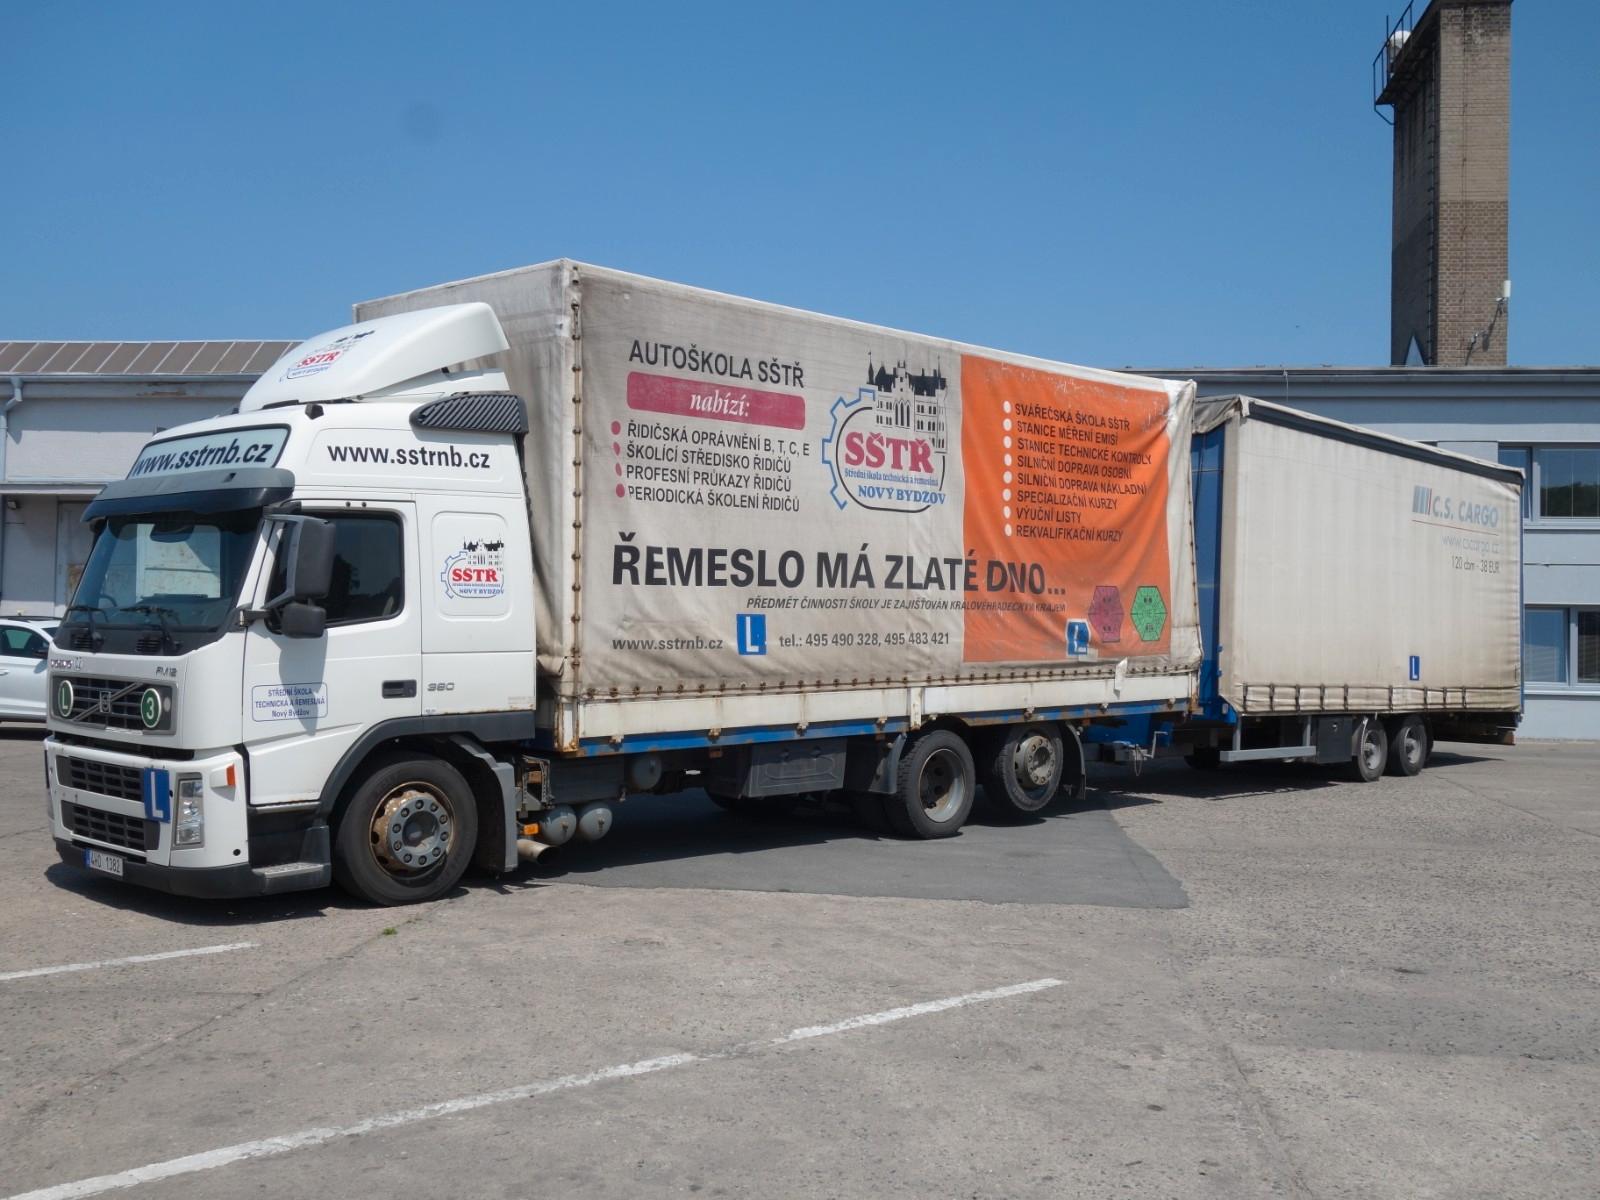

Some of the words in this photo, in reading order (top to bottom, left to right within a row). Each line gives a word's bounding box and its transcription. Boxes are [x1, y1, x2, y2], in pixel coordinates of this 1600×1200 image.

[628, 339, 753, 381] AUTOŠKOLA
[758, 357, 804, 388] SŠTŘ
[689, 389, 750, 417] nabízí:
[1015, 403, 1073, 421] SVÁŘEČSKÁ
[1075, 410, 1106, 428] ŠKOLA
[1108, 415, 1130, 431] SŠTŘ
[627, 420, 688, 443] ŘIDIČSKÁ
[691, 430, 760, 450] OPRÁVNĚNÍ
[763, 438, 774, 454] B,
[777, 440, 786, 456] T,
[789, 441, 800, 456] C,
[803, 443, 810, 456] E
[1017, 421, 1056, 438] STANICE
[1058, 426, 1093, 442] MĚŘENÍ
[1095, 431, 1118, 445] EMISÍ
[132, 438, 274, 477] www.sstrnb.cz
[327, 445, 490, 468] www.sstrnb.cz
[627, 440, 678, 462] ŠKOLÍCÍ
[682, 448, 749, 469] STŘEDISKO
[753, 455, 791, 473] ŘIDIČŮ
[845, 431, 934, 474] SŠTŘ
[1017, 438, 1055, 454] STANICE
[1058, 444, 1109, 461] TECHNICKÉ
[1111, 451, 1152, 465] KONTROLY
[627, 465, 689, 484] PROFESNÍ
[693, 470, 750, 489] PRŮKAZY
[753, 474, 791, 492] ŘIDIČŮ
[1017, 455, 1055, 471] SILNIČNÍ
[1058, 461, 1099, 476] DOPRAVA
[1101, 466, 1131, 479] OSOBNÍ
[1017, 472, 1057, 488] SILNIČNÍ
[1058, 478, 1099, 493] DOPRAVA
[1101, 481, 1147, 496] NÁKLADNÍ
[628, 485, 704, 505] PERIODICKÁ
[707, 489, 758, 509] ŠKOLENÍ
[762, 494, 799, 512] ŘIDIČŮ
[1017, 489, 1087, 507] SPECIALIZAČNÍ
[1089, 497, 1117, 510] KURZY
[1016, 505, 1054, 521] VÝUČNÍ
[1056, 511, 1081, 523] LISTY
[1433, 496, 1453, 520] C.S.
[1458, 500, 1499, 528] CARGO
[1017, 525, 1094, 540] REKVALIFIKAČNÍ
[1096, 528, 1123, 542] KURZY
[612, 532, 805, 588] ŘEMESLO
[816, 543, 875, 589] MÁ
[884, 549, 979, 591] ZLATÉ
[987, 560, 1066, 595] DNO...
[747, 596, 799, 609] PŘEDMĚT
[800, 596, 849, 609] ČINNOSTI
[849, 596, 880, 609] ŠKOLY
[881, 599, 892, 609] JE
[612, 636, 723, 650] www.sstrnb.cz
[779, 633, 802, 647] tel.:
[805, 633, 828, 647] 495
[832, 633, 854, 647] 490
[857, 632, 881, 647] 328,
[884, 632, 905, 646] 495
[908, 632, 929, 645] 483
[931, 632, 949, 645] 421
[146, 697, 155, 720] 3
[272, 710, 287, 718] Nový
